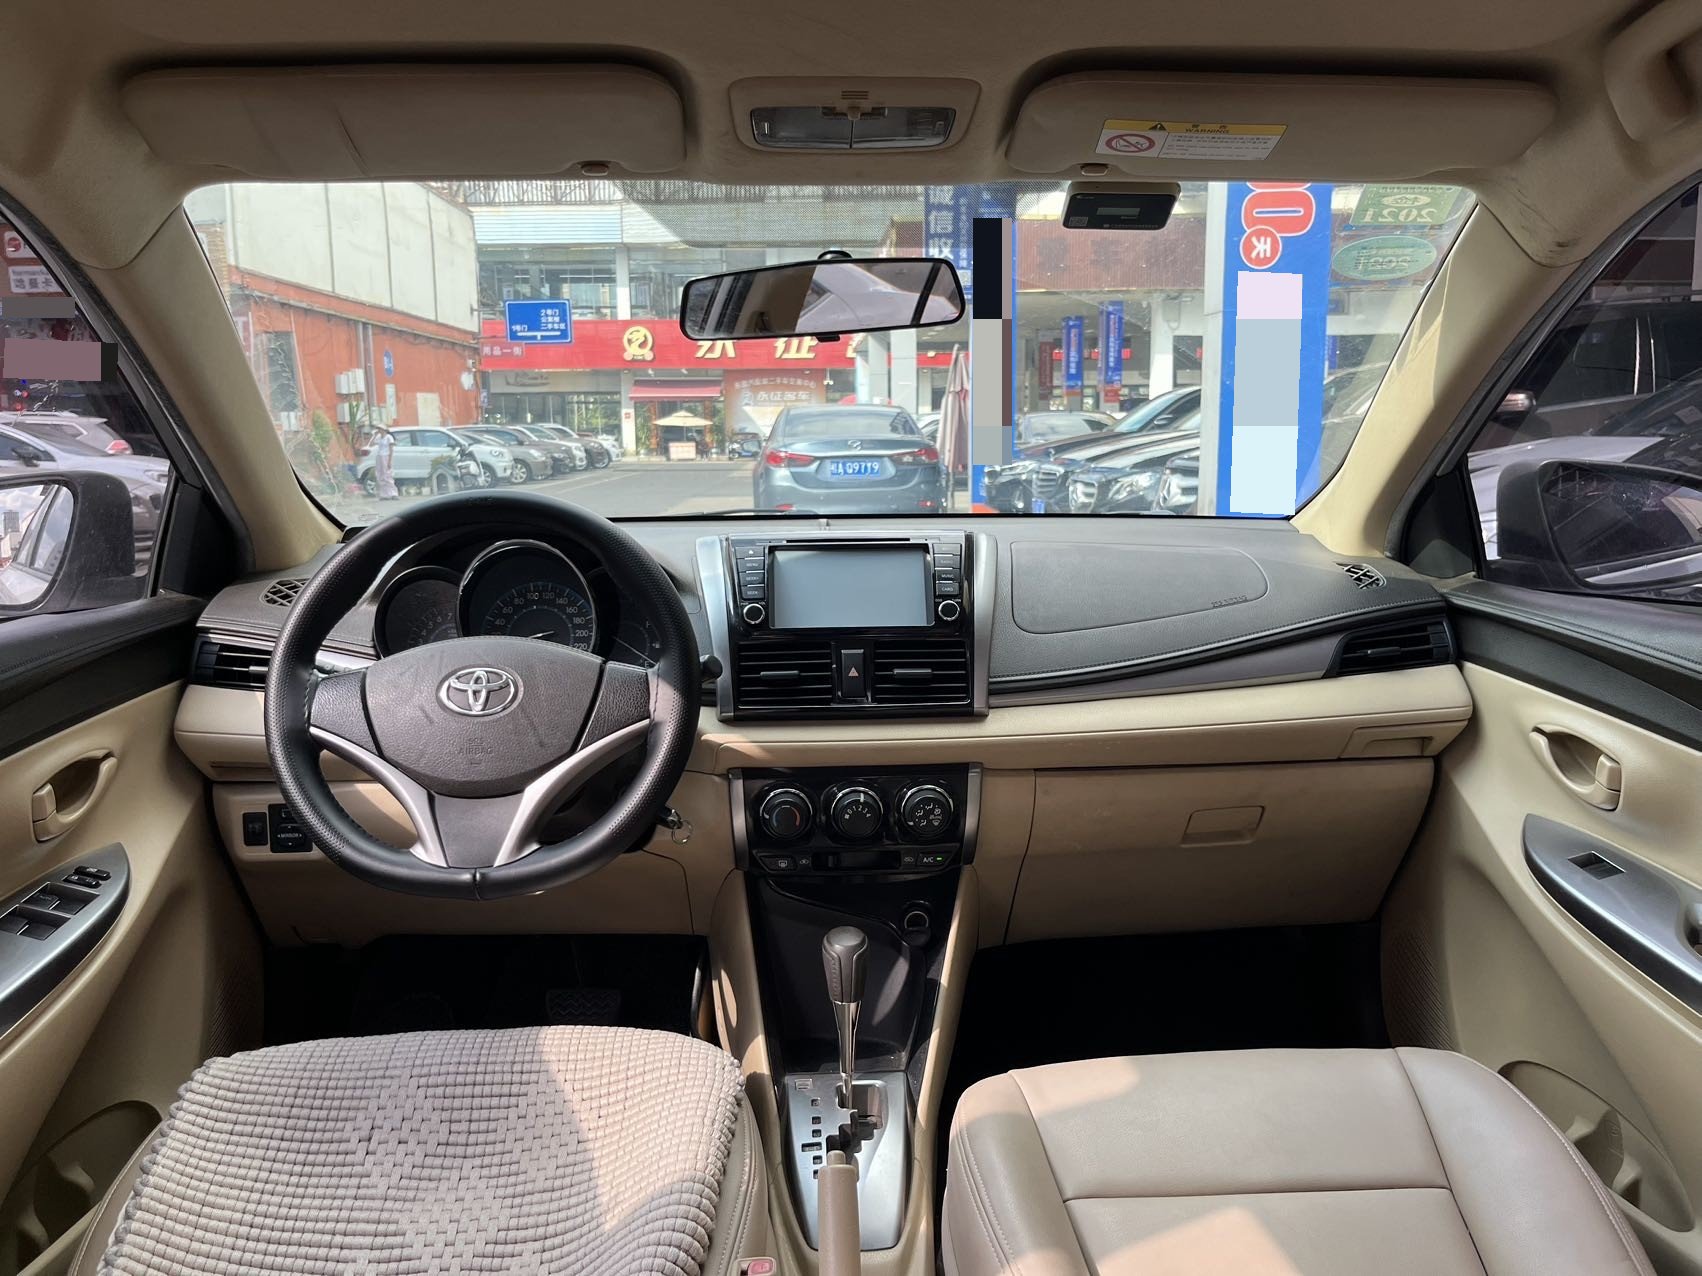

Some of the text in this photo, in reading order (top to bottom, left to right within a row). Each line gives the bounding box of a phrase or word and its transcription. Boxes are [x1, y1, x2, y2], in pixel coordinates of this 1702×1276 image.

[527, 592, 539, 600] 100
[514, 597, 525, 605] 80
[556, 597, 569, 605] 140
[502, 606, 513, 614] 60
[565, 606, 578, 614] 160
[572, 616, 585, 624] 180
[575, 629, 589, 637] 200
[573, 642, 588, 650] 220
